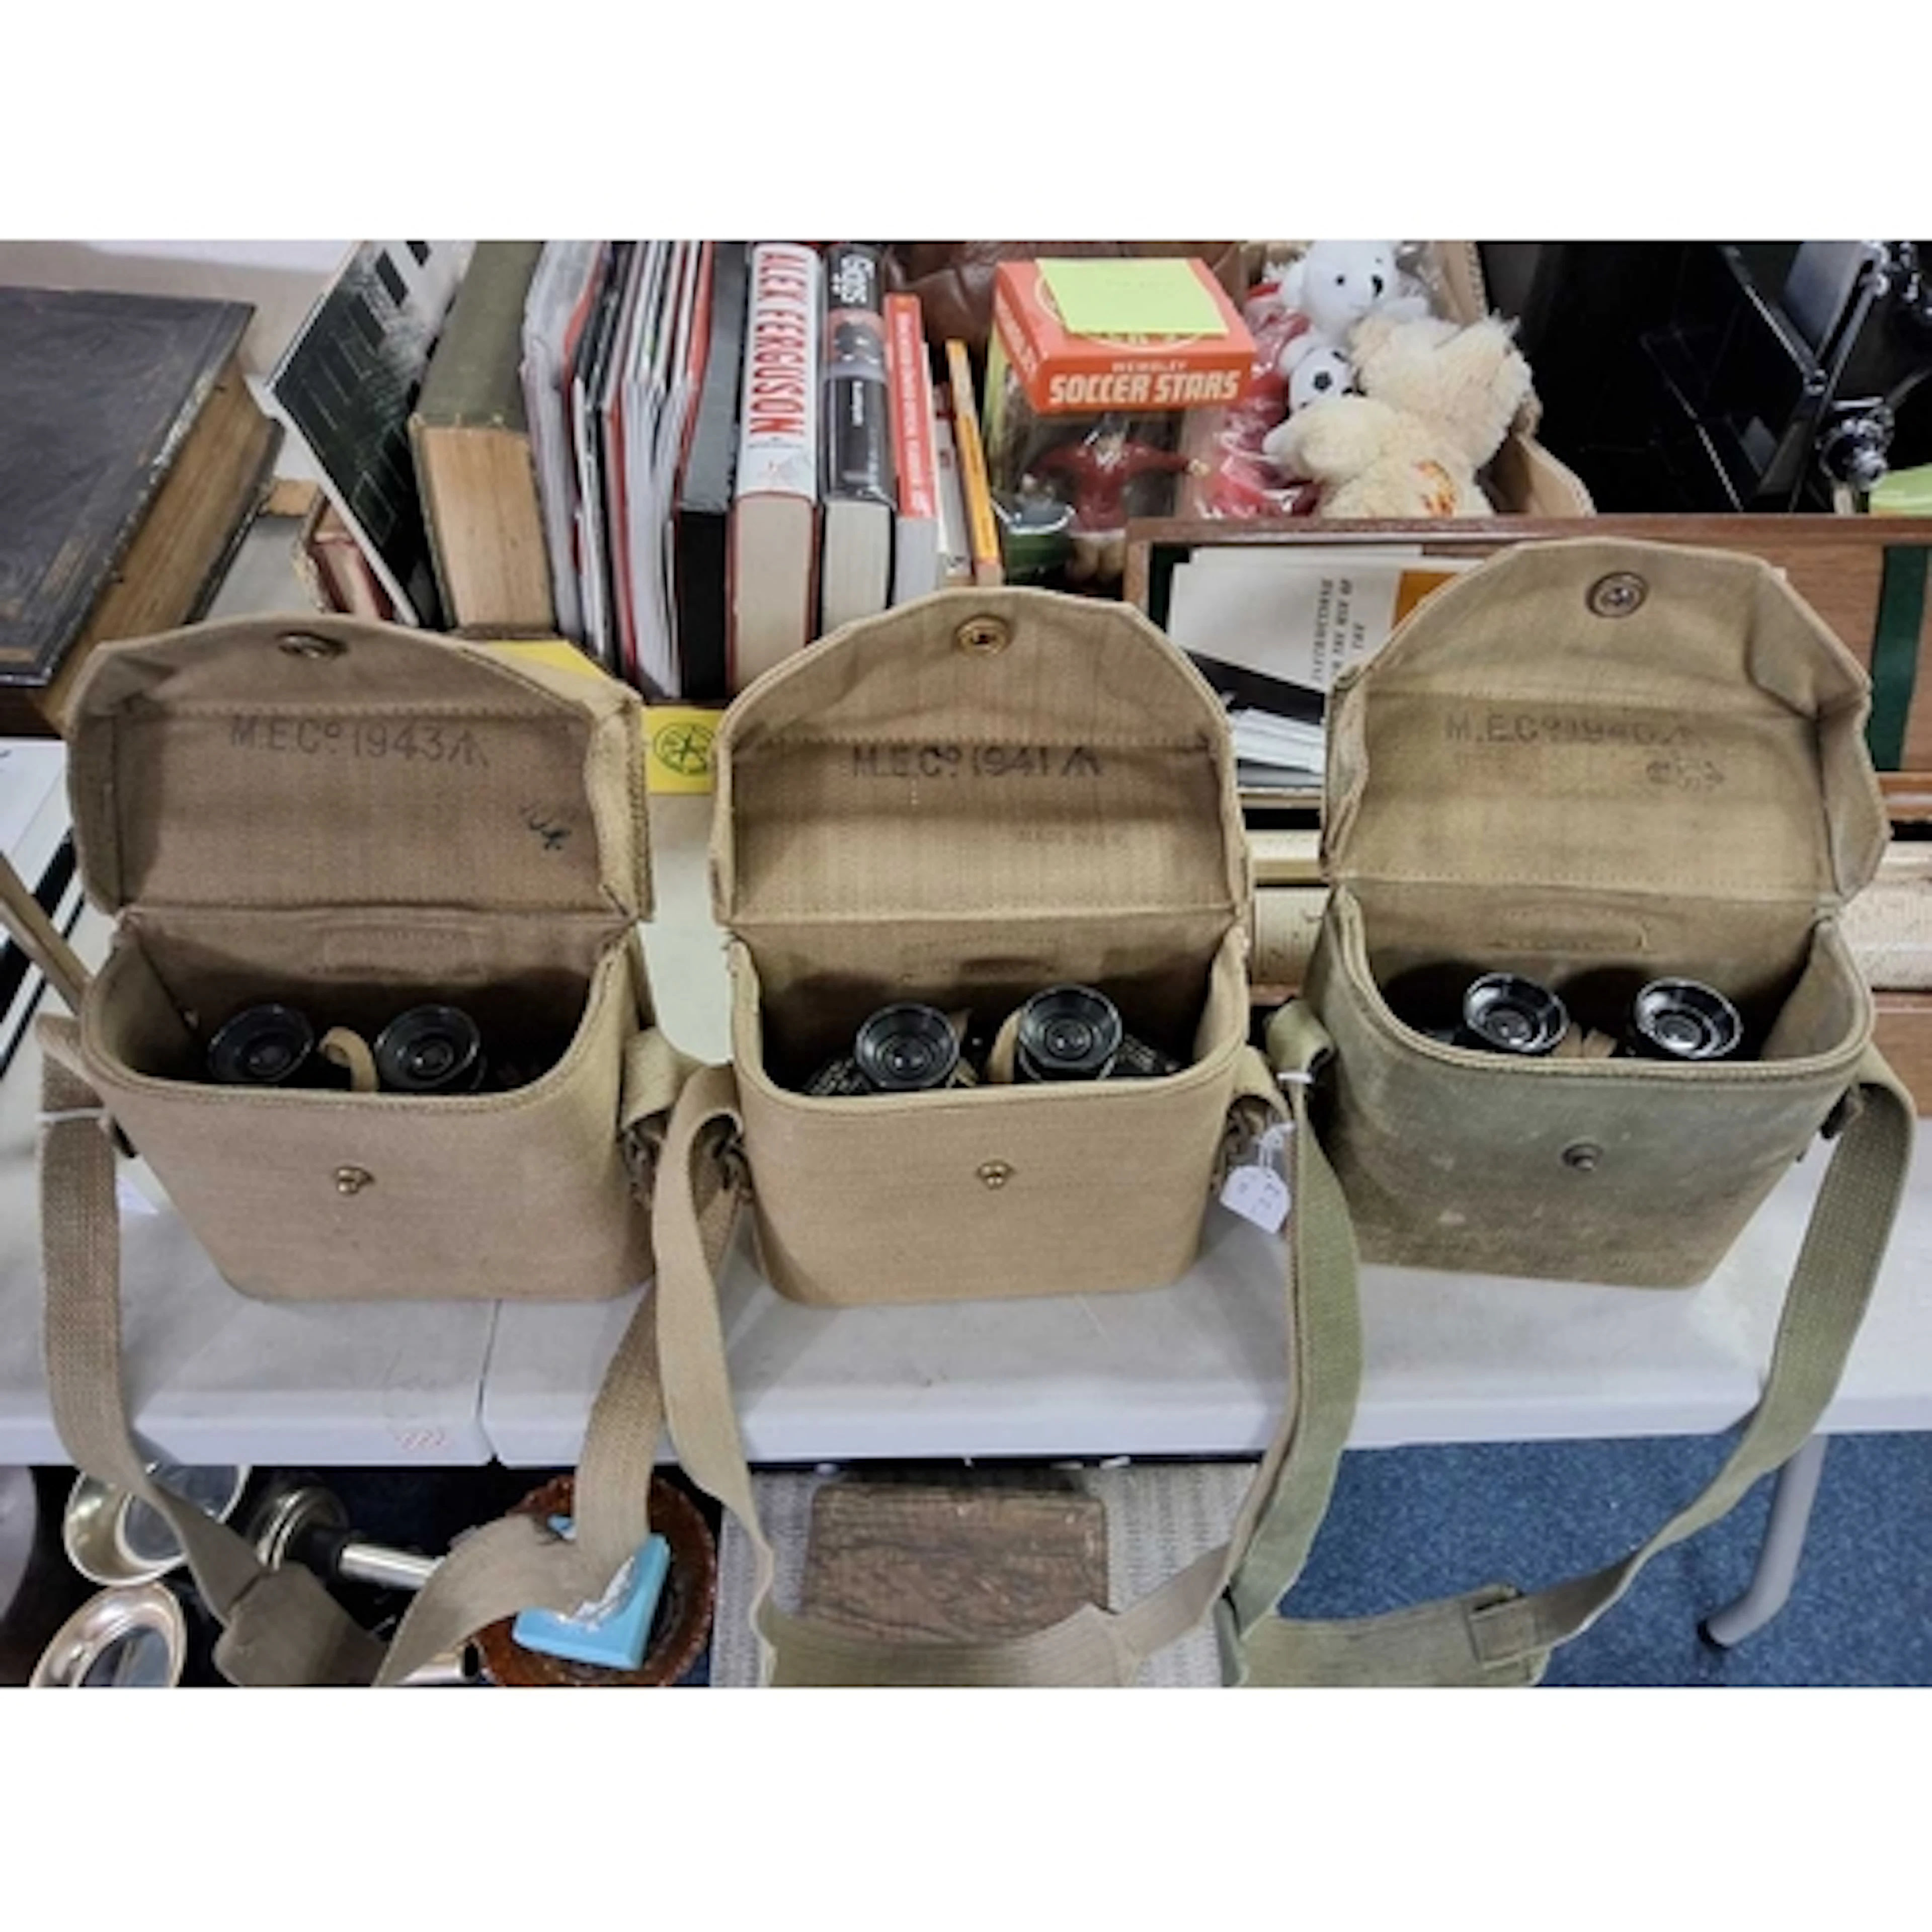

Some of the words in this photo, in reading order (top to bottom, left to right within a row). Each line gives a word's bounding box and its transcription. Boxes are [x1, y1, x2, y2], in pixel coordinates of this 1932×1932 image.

[758, 252, 807, 302] ALEX
[750, 307, 806, 436] FERGUSON
[1050, 373, 1151, 404] SOCCER
[1155, 369, 1242, 404] STARS
